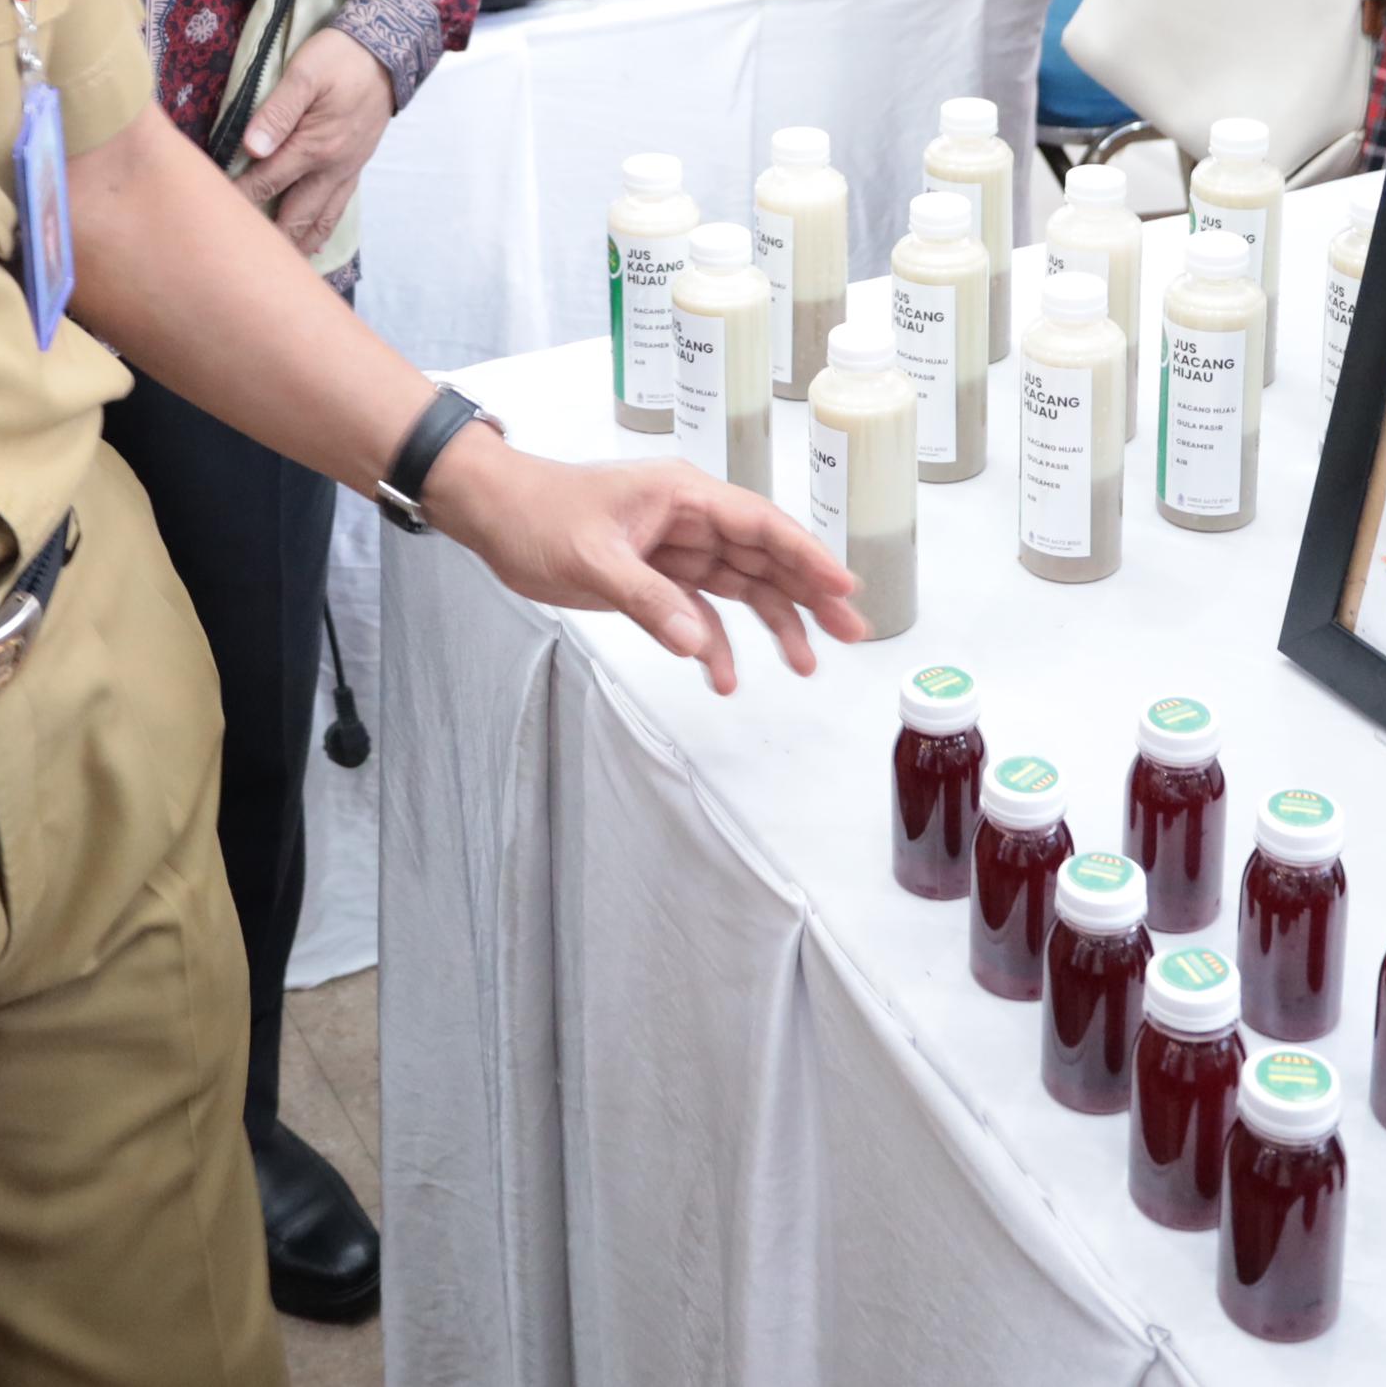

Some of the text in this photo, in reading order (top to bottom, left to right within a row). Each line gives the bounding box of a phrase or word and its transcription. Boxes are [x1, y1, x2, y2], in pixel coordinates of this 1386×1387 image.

[1201, 214, 1222, 230] JUS
[627, 248, 651, 261] JUS
[627, 260, 685, 274] KACANG
[627, 273, 667, 286] HIJAU
[1173, 338, 1197, 354] JUS
[1173, 350, 1235, 370] KACANG
[1024, 371, 1043, 389] JUS
[1173, 367, 1214, 384] HIJAU
[1023, 386, 1080, 409] KACANG
[1024, 401, 1058, 420] HIJAU
